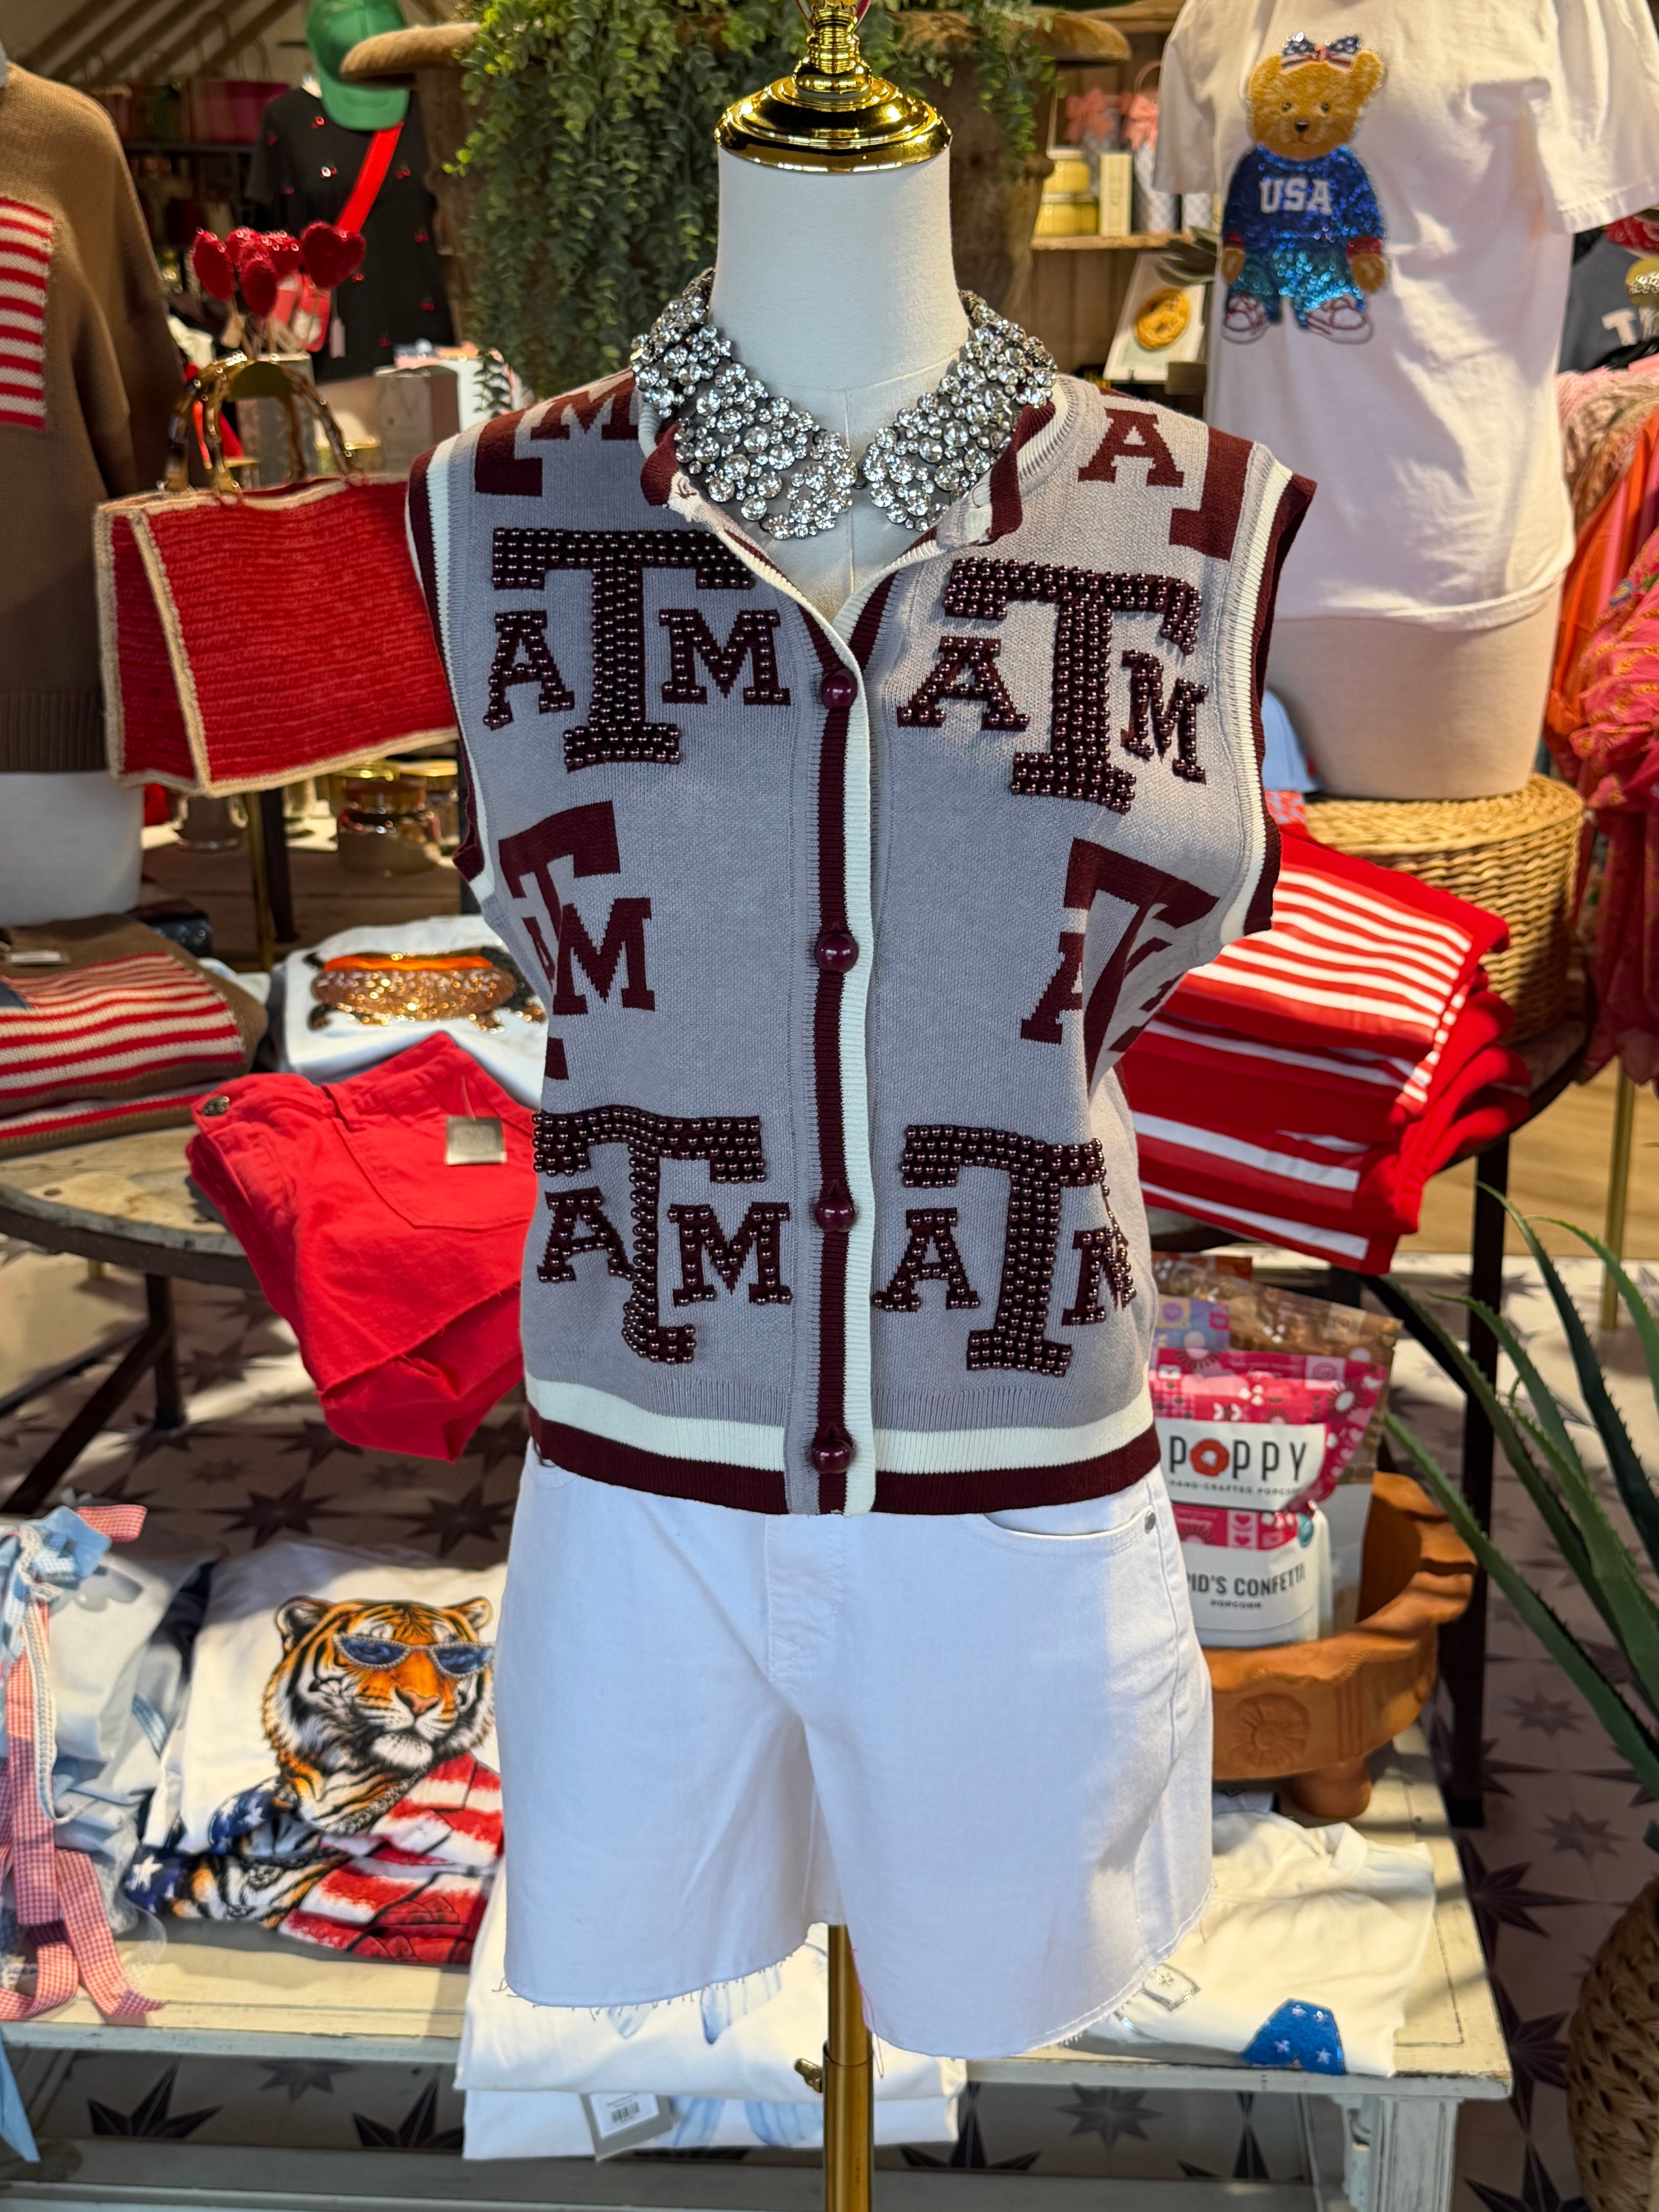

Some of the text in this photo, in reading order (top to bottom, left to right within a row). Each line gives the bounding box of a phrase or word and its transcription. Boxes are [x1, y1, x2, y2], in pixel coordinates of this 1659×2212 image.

[1259, 177, 1333, 216] USA
[1170, 1435, 1307, 1482] POPPY
[1234, 1562, 1304, 1596] CONFETTI
